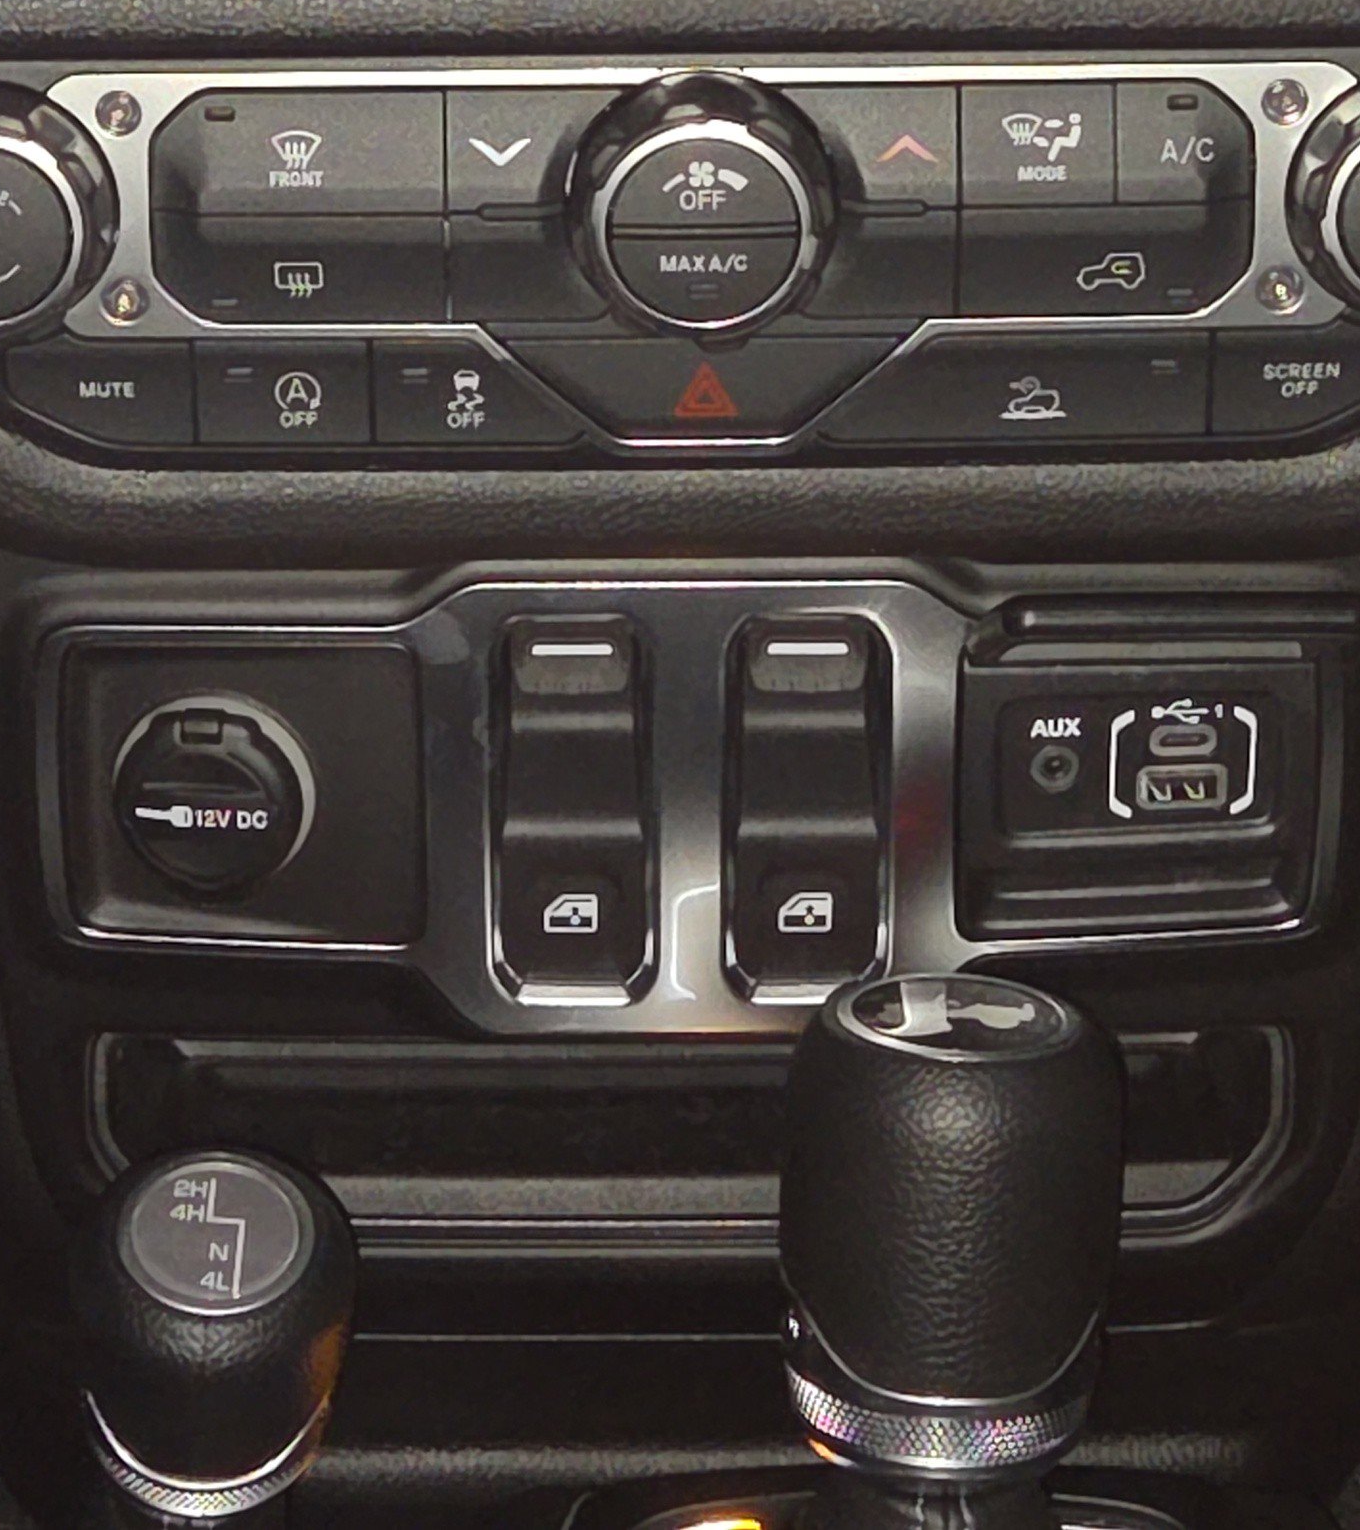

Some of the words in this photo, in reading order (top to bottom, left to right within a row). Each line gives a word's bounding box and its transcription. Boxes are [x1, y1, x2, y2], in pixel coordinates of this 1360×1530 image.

[1160, 136, 1215, 165] A/C
[269, 170, 324, 188] FRONT
[1017, 165, 1067, 182] MODE
[679, 190, 727, 211] OFF
[660, 254, 706, 273] MAX
[708, 253, 748, 274] A/C
[1263, 362, 1340, 381] SCREEN
[79, 381, 135, 399] MUTE
[1281, 380, 1319, 398] OFF
[279, 411, 318, 429] OFF
[446, 410, 485, 429] OFF
[1030, 717, 1081, 738] AUX
[194, 809, 232, 828] 12V
[236, 809, 268, 830] DC
[173, 1179, 208, 1199] 2H
[169, 1204, 205, 1223] 4H
[208, 1241, 229, 1262] N
[200, 1271, 230, 1291] 4L
